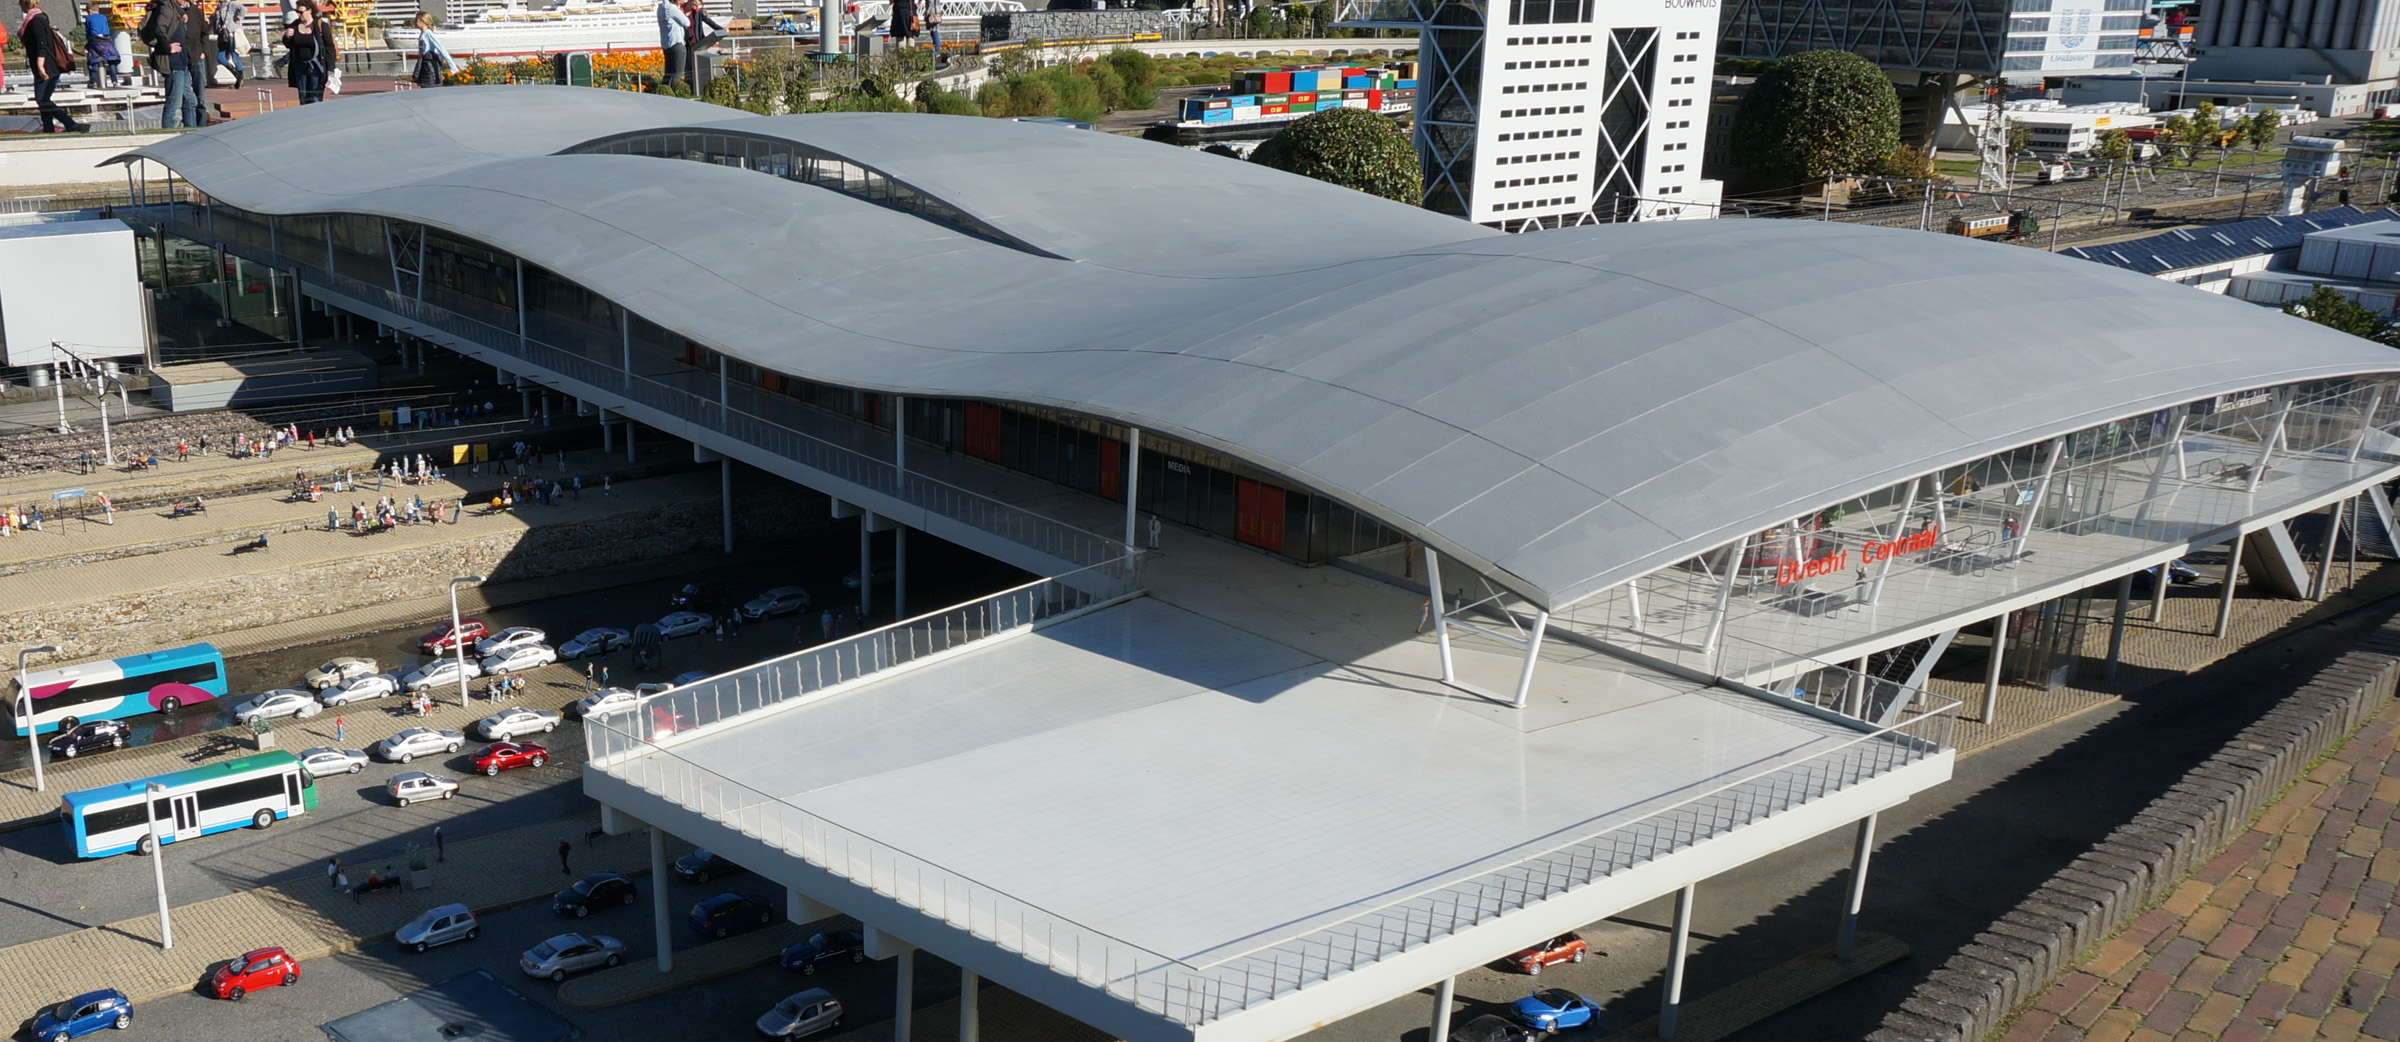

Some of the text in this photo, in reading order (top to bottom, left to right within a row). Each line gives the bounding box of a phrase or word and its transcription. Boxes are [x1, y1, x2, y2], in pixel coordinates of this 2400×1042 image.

[1167, 460, 1192, 475] MEDIA
[1778, 525, 1939, 586] Utrecht Centraal
